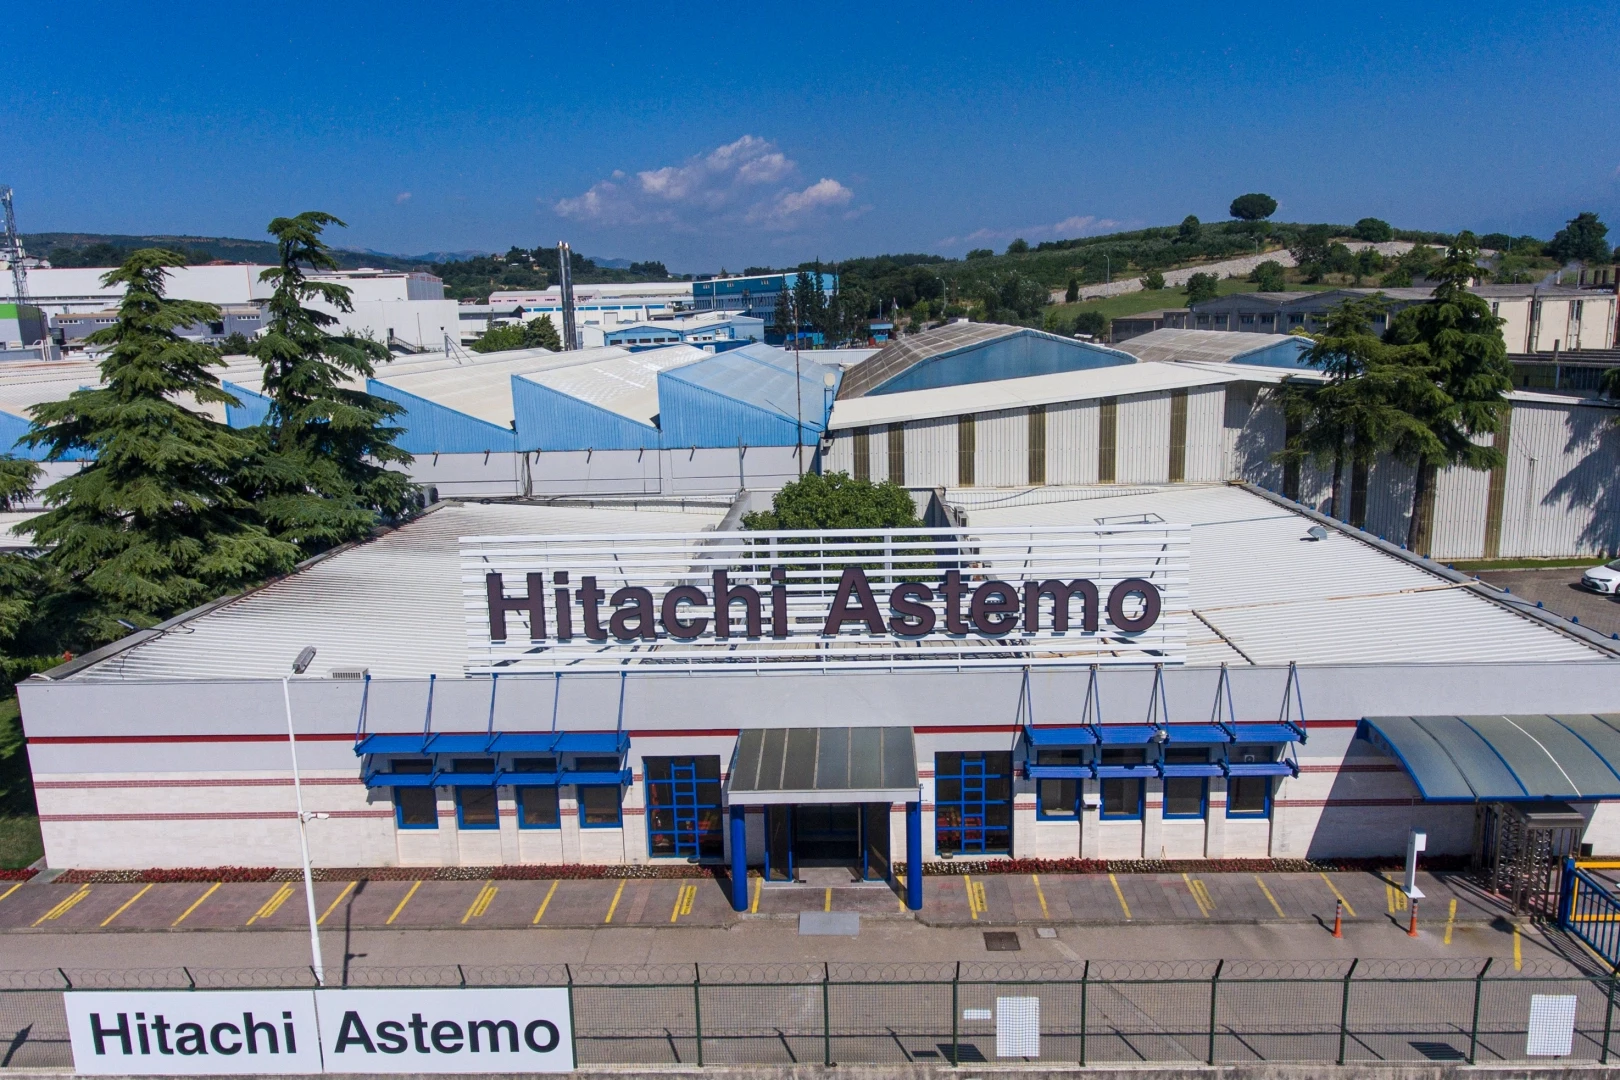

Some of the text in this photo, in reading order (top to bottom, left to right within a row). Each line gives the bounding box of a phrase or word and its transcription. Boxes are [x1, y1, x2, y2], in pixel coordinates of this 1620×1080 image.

[485, 566, 1163, 641] Hitachi Astemo
[90, 1010, 560, 1056] Hitachi Astemo
